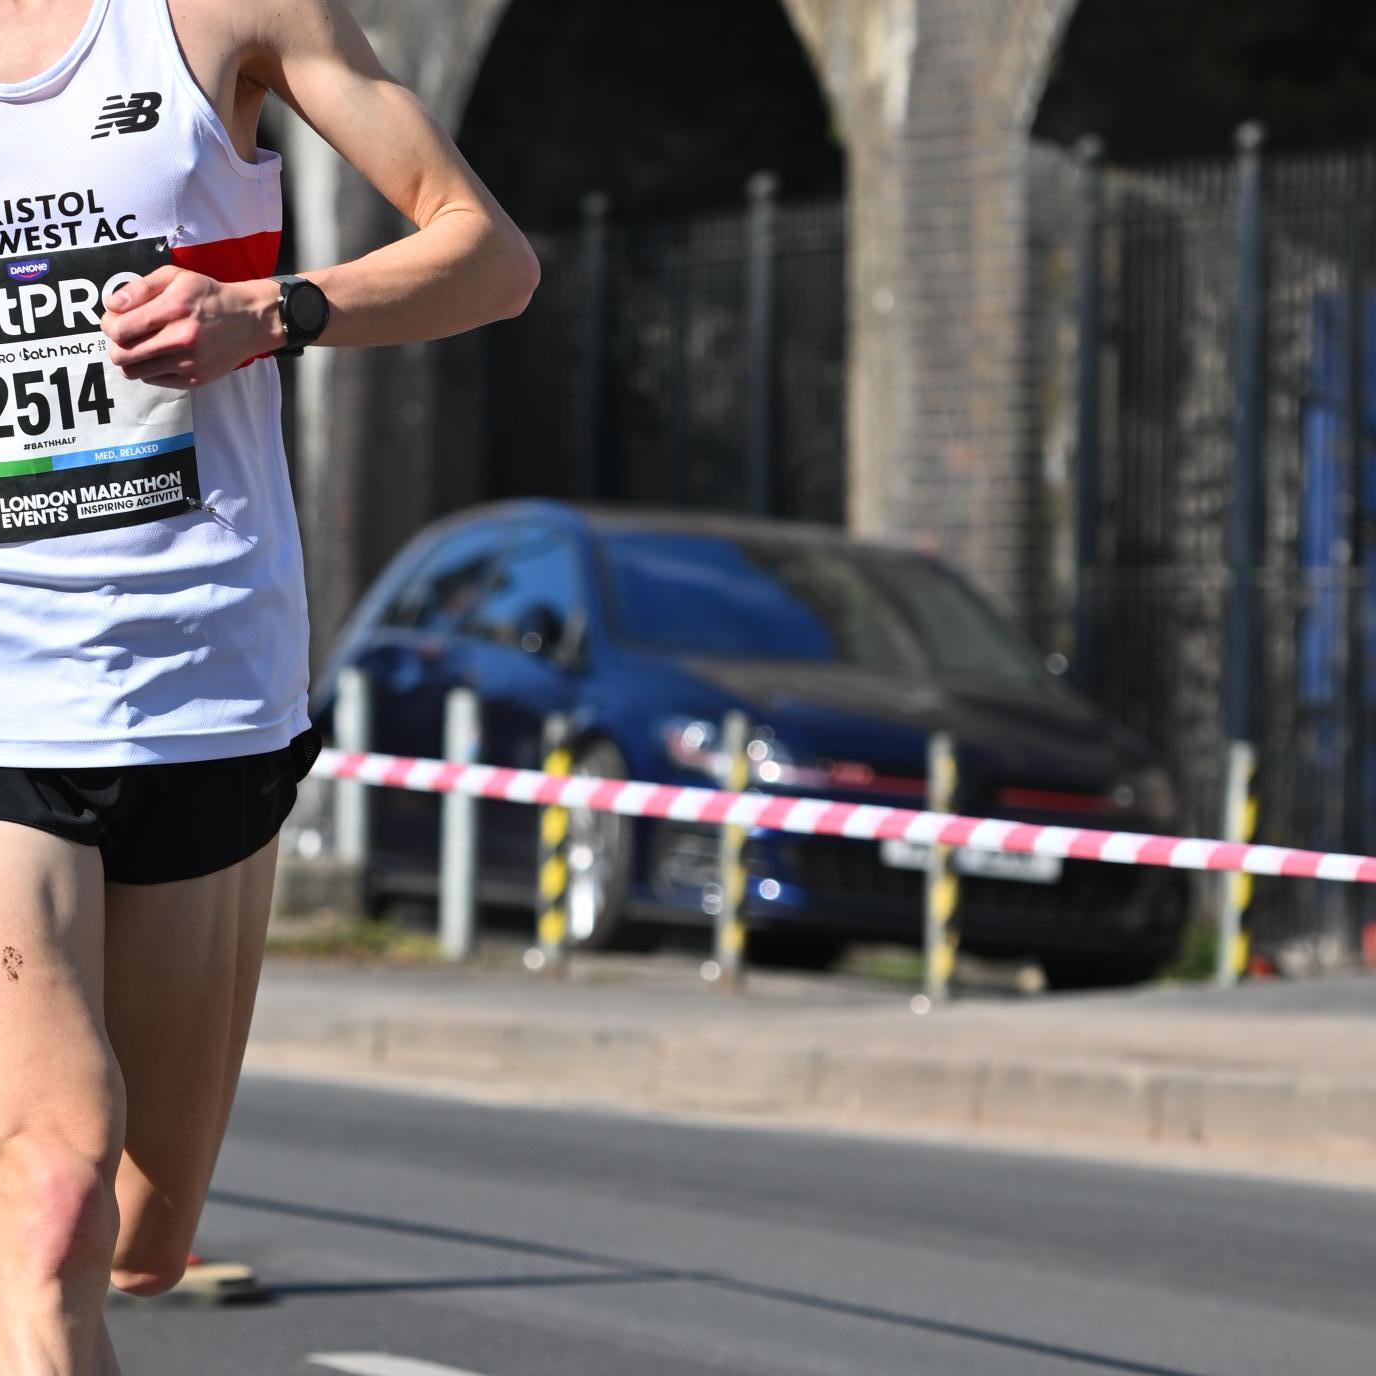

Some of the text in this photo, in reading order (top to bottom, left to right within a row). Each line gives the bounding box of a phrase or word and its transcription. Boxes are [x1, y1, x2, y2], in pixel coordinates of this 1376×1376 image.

[93, 214, 139, 244] AC
[23, 436, 77, 451] #BATHHALF
[120, 444, 159, 458] RELAXED
[0, 470, 182, 513] LONDON MARATHON
[80, 488, 181, 516] INSPIRING ACTIVITY
[1, 506, 69, 529] EVENTS
